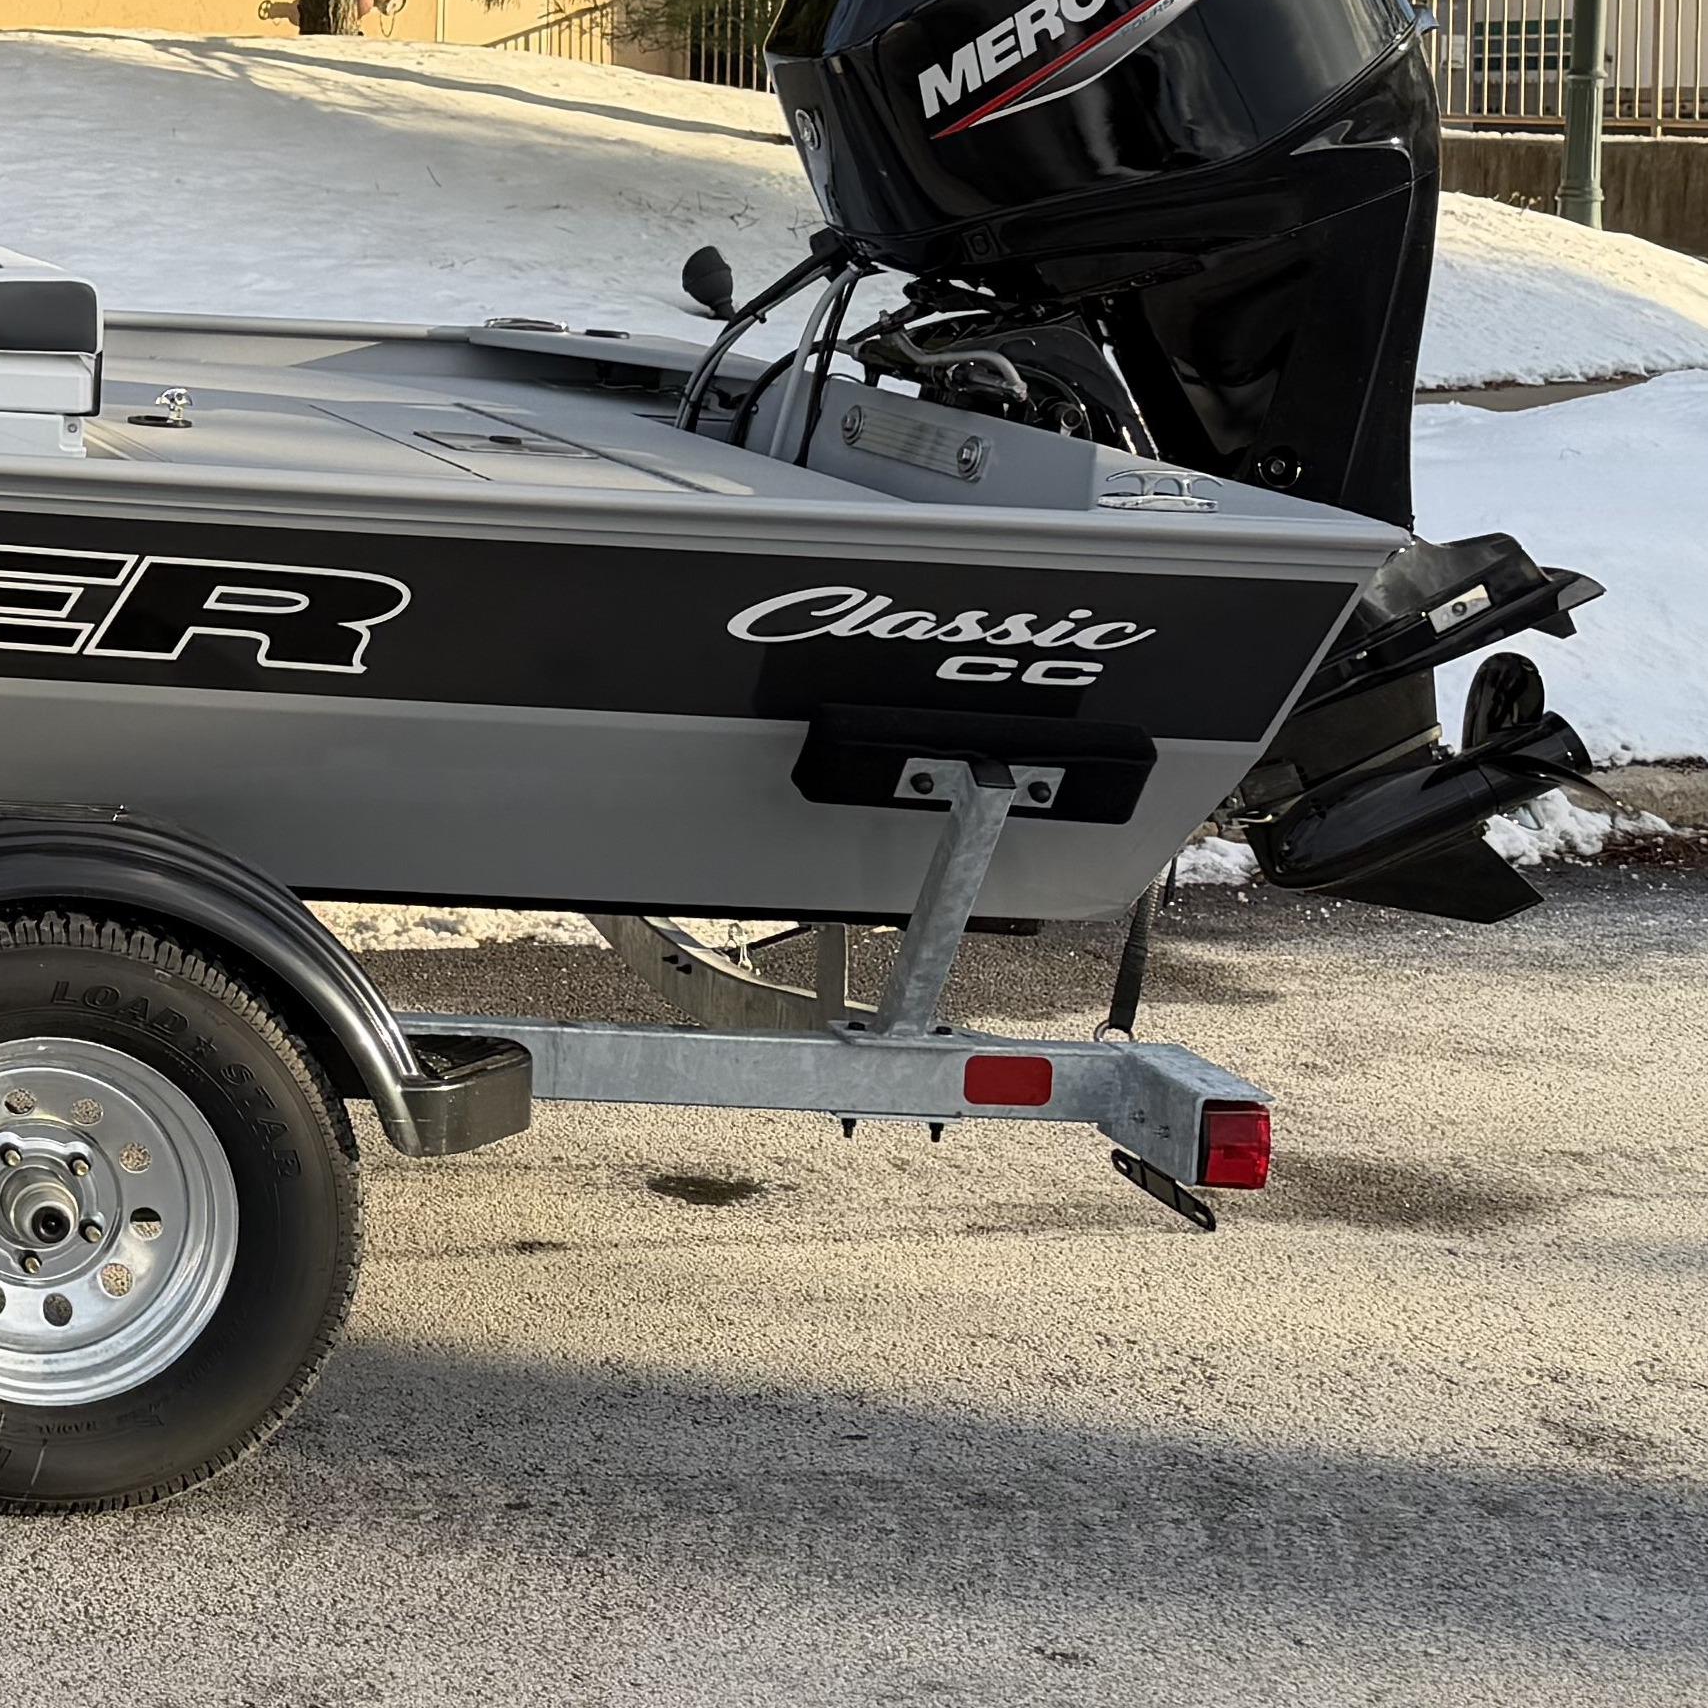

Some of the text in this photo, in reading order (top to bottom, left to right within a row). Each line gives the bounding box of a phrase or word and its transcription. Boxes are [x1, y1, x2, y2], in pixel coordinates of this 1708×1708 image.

[727, 586, 1157, 650] Classic
[936, 656, 1104, 686] CC
[49, 980, 191, 1035] LOAD
